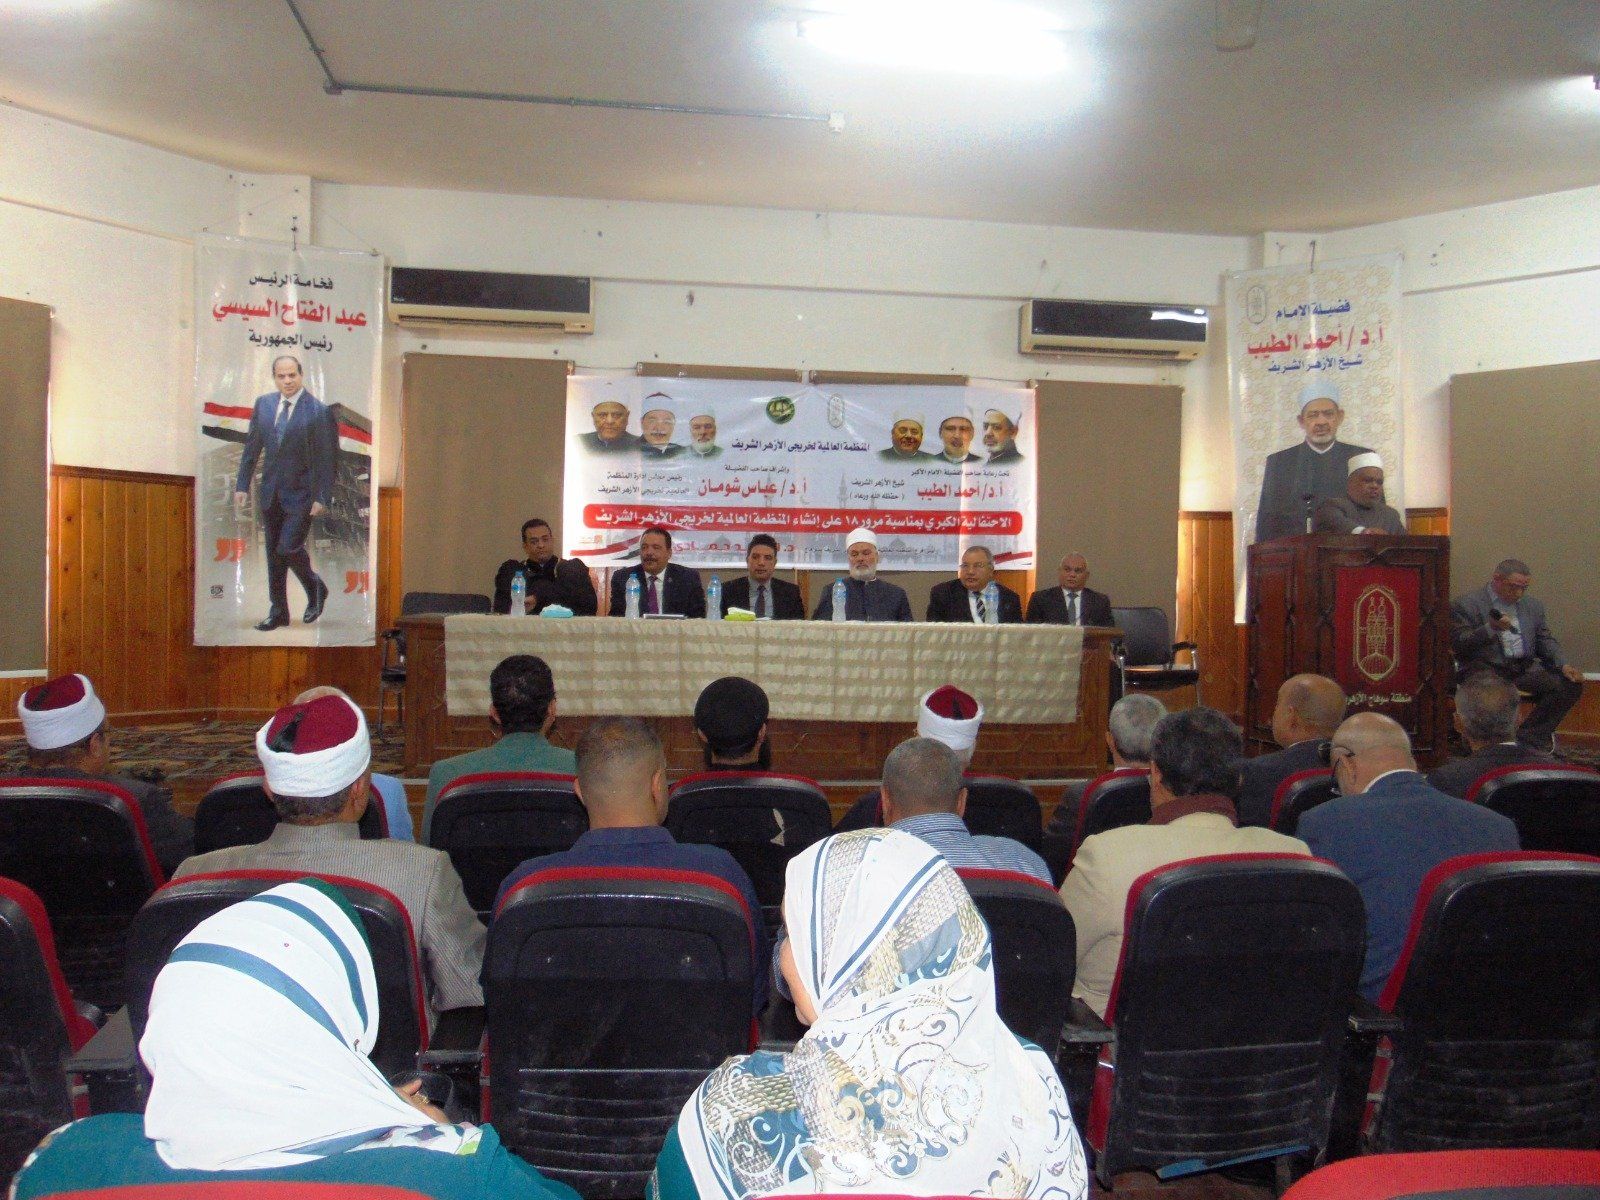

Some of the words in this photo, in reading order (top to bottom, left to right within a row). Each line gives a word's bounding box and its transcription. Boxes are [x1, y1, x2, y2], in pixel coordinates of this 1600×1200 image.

[249, 272, 291, 288] الرئيس
[294, 274, 333, 290] فخامة
[212, 297, 279, 322] السيسي
[281, 300, 330, 326] الفتاح
[1312, 299, 1351, 316] فضيلة
[335, 308, 367, 331] عبد
[248, 329, 303, 348] الجمهورية
[303, 335, 333, 351] رئيس
[1247, 333, 1299, 359] الطيب
[1268, 359, 1305, 374] الشريف
[1338, 353, 1363, 370] شيخ
[731, 438, 761, 451] الشريف
[818, 440, 843, 453] العالمية
[844, 440, 870, 452] المنظمة
[698, 476, 741, 497] شومان
[742, 480, 778, 498] عباس
[917, 482, 952, 501] الطيب
[595, 509, 638, 525] الشريف
[717, 511, 752, 527] العالمية
[753, 511, 790, 526] المنظمة
[860, 517, 883, 530] مرور
[885, 513, 923, 529] بمناسبة
[961, 513, 1012, 530] الاحتفالية
